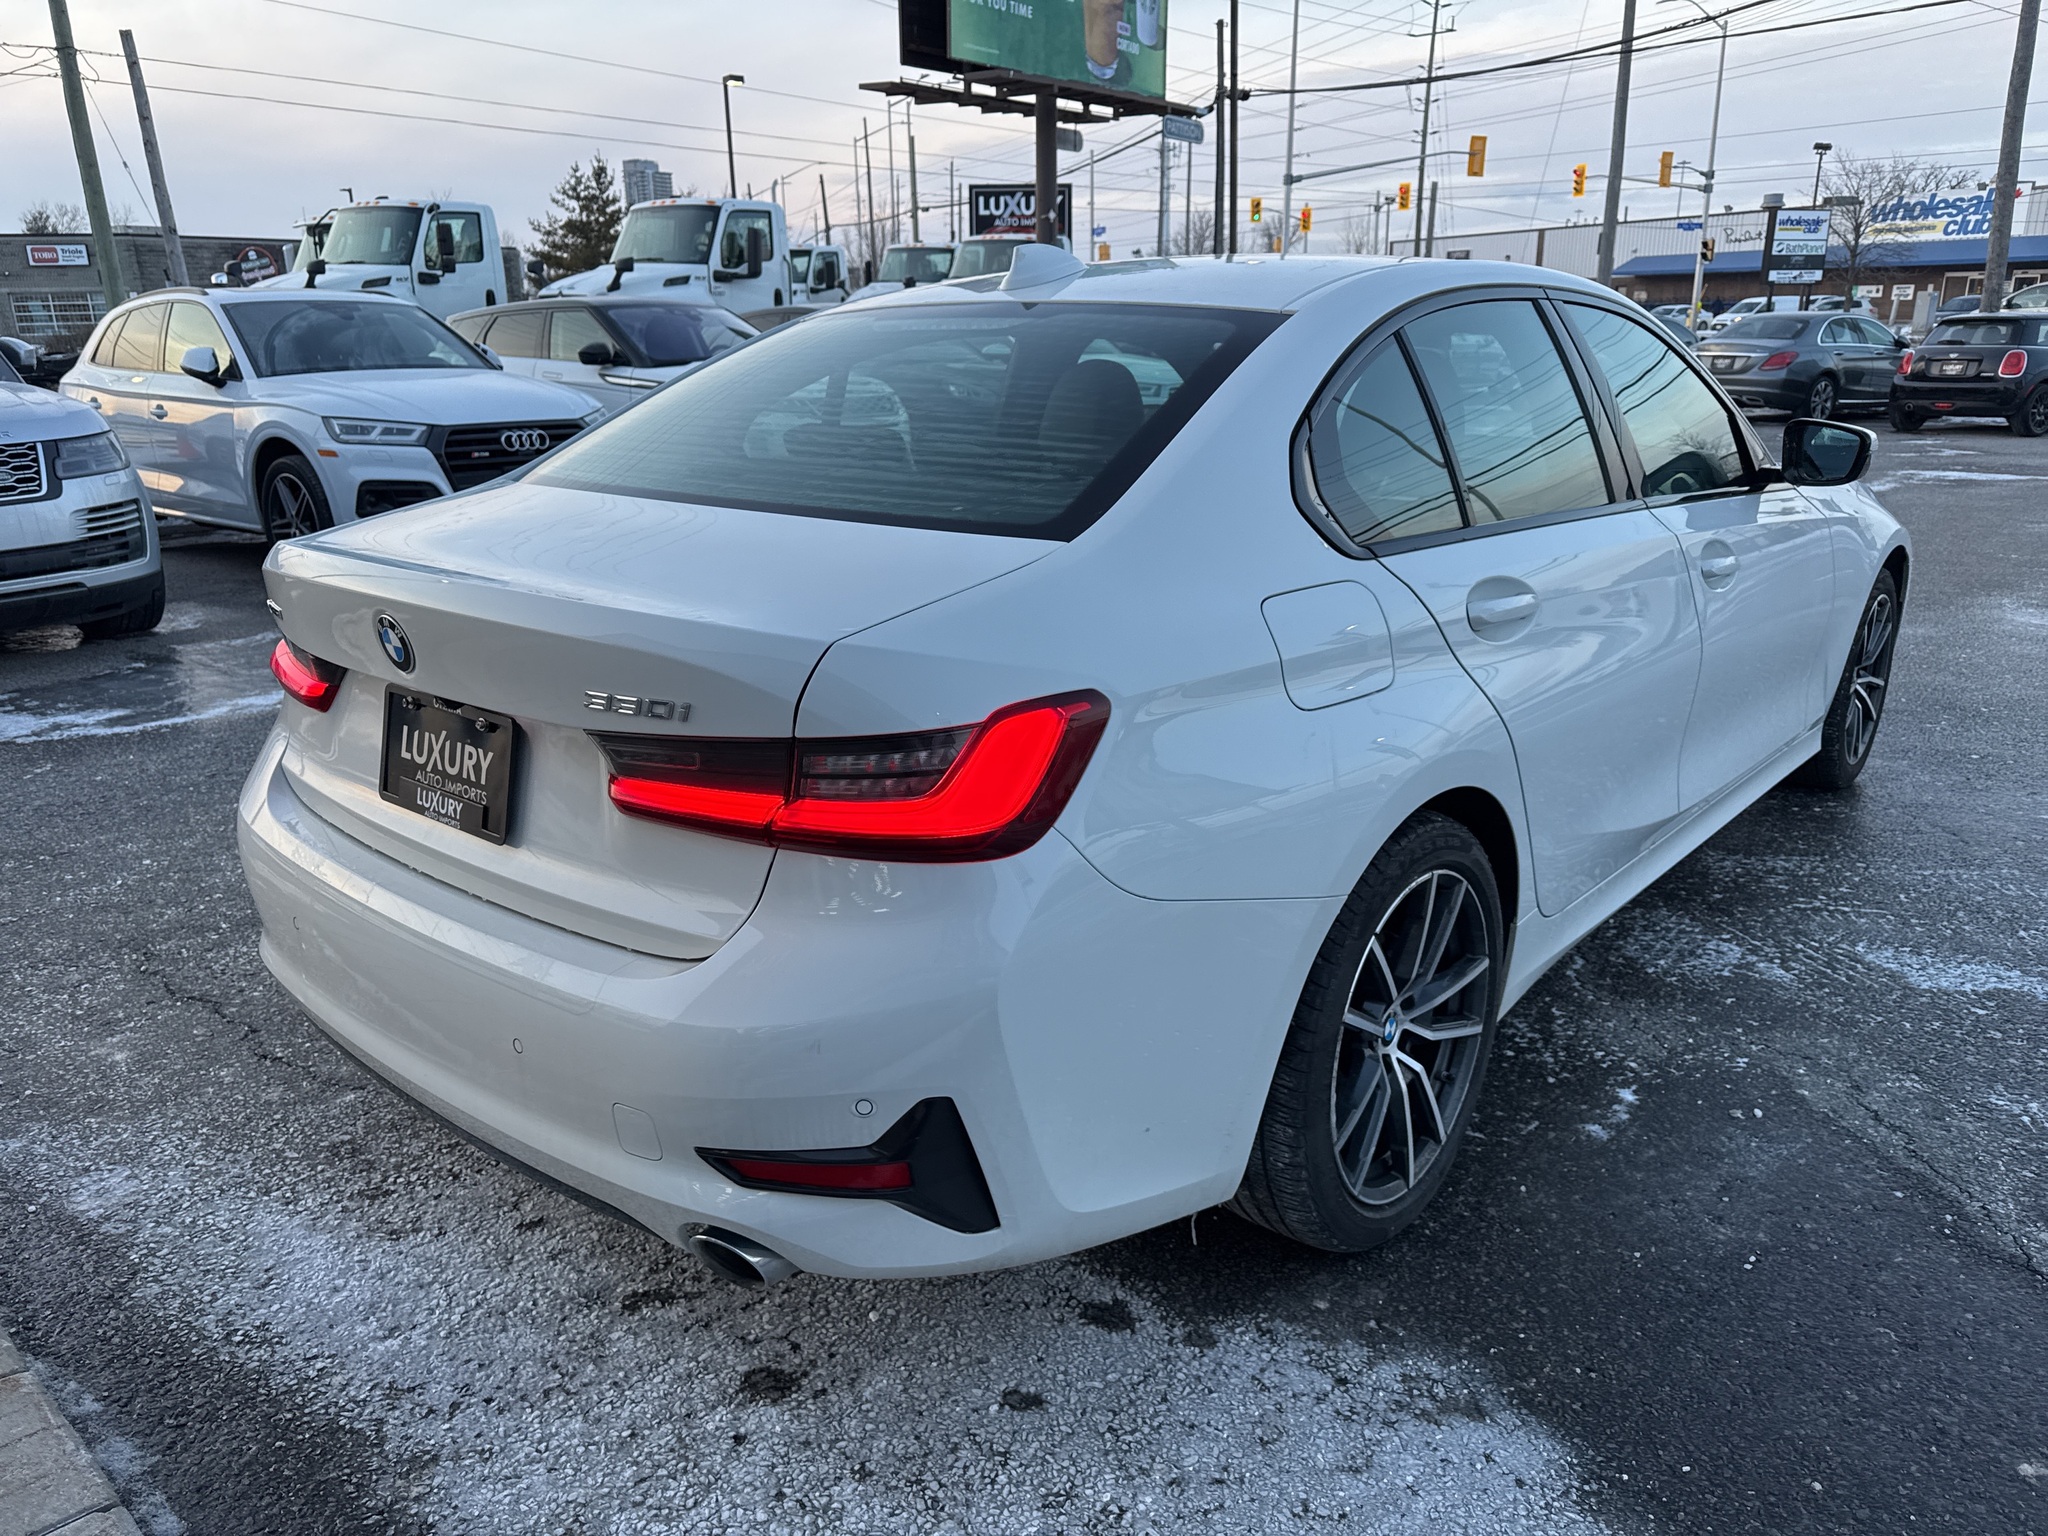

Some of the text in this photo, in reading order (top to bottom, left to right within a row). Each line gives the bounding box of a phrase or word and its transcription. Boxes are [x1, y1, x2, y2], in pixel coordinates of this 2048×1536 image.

[1009, 1, 1033, 19] TIME
[978, 192, 1064, 218] LUXU
[993, 218, 1020, 227] AUTO
[1778, 215, 1824, 227] wholesale
[33, 251, 58, 260] TORO
[583, 690, 691, 722] 330i
[401, 724, 494, 786] LUXURY
[415, 769, 488, 805] AUTO IMPORTS
[417, 786, 464, 820] LUXURY
[424, 809, 461, 830] AUTO IMPORTS
